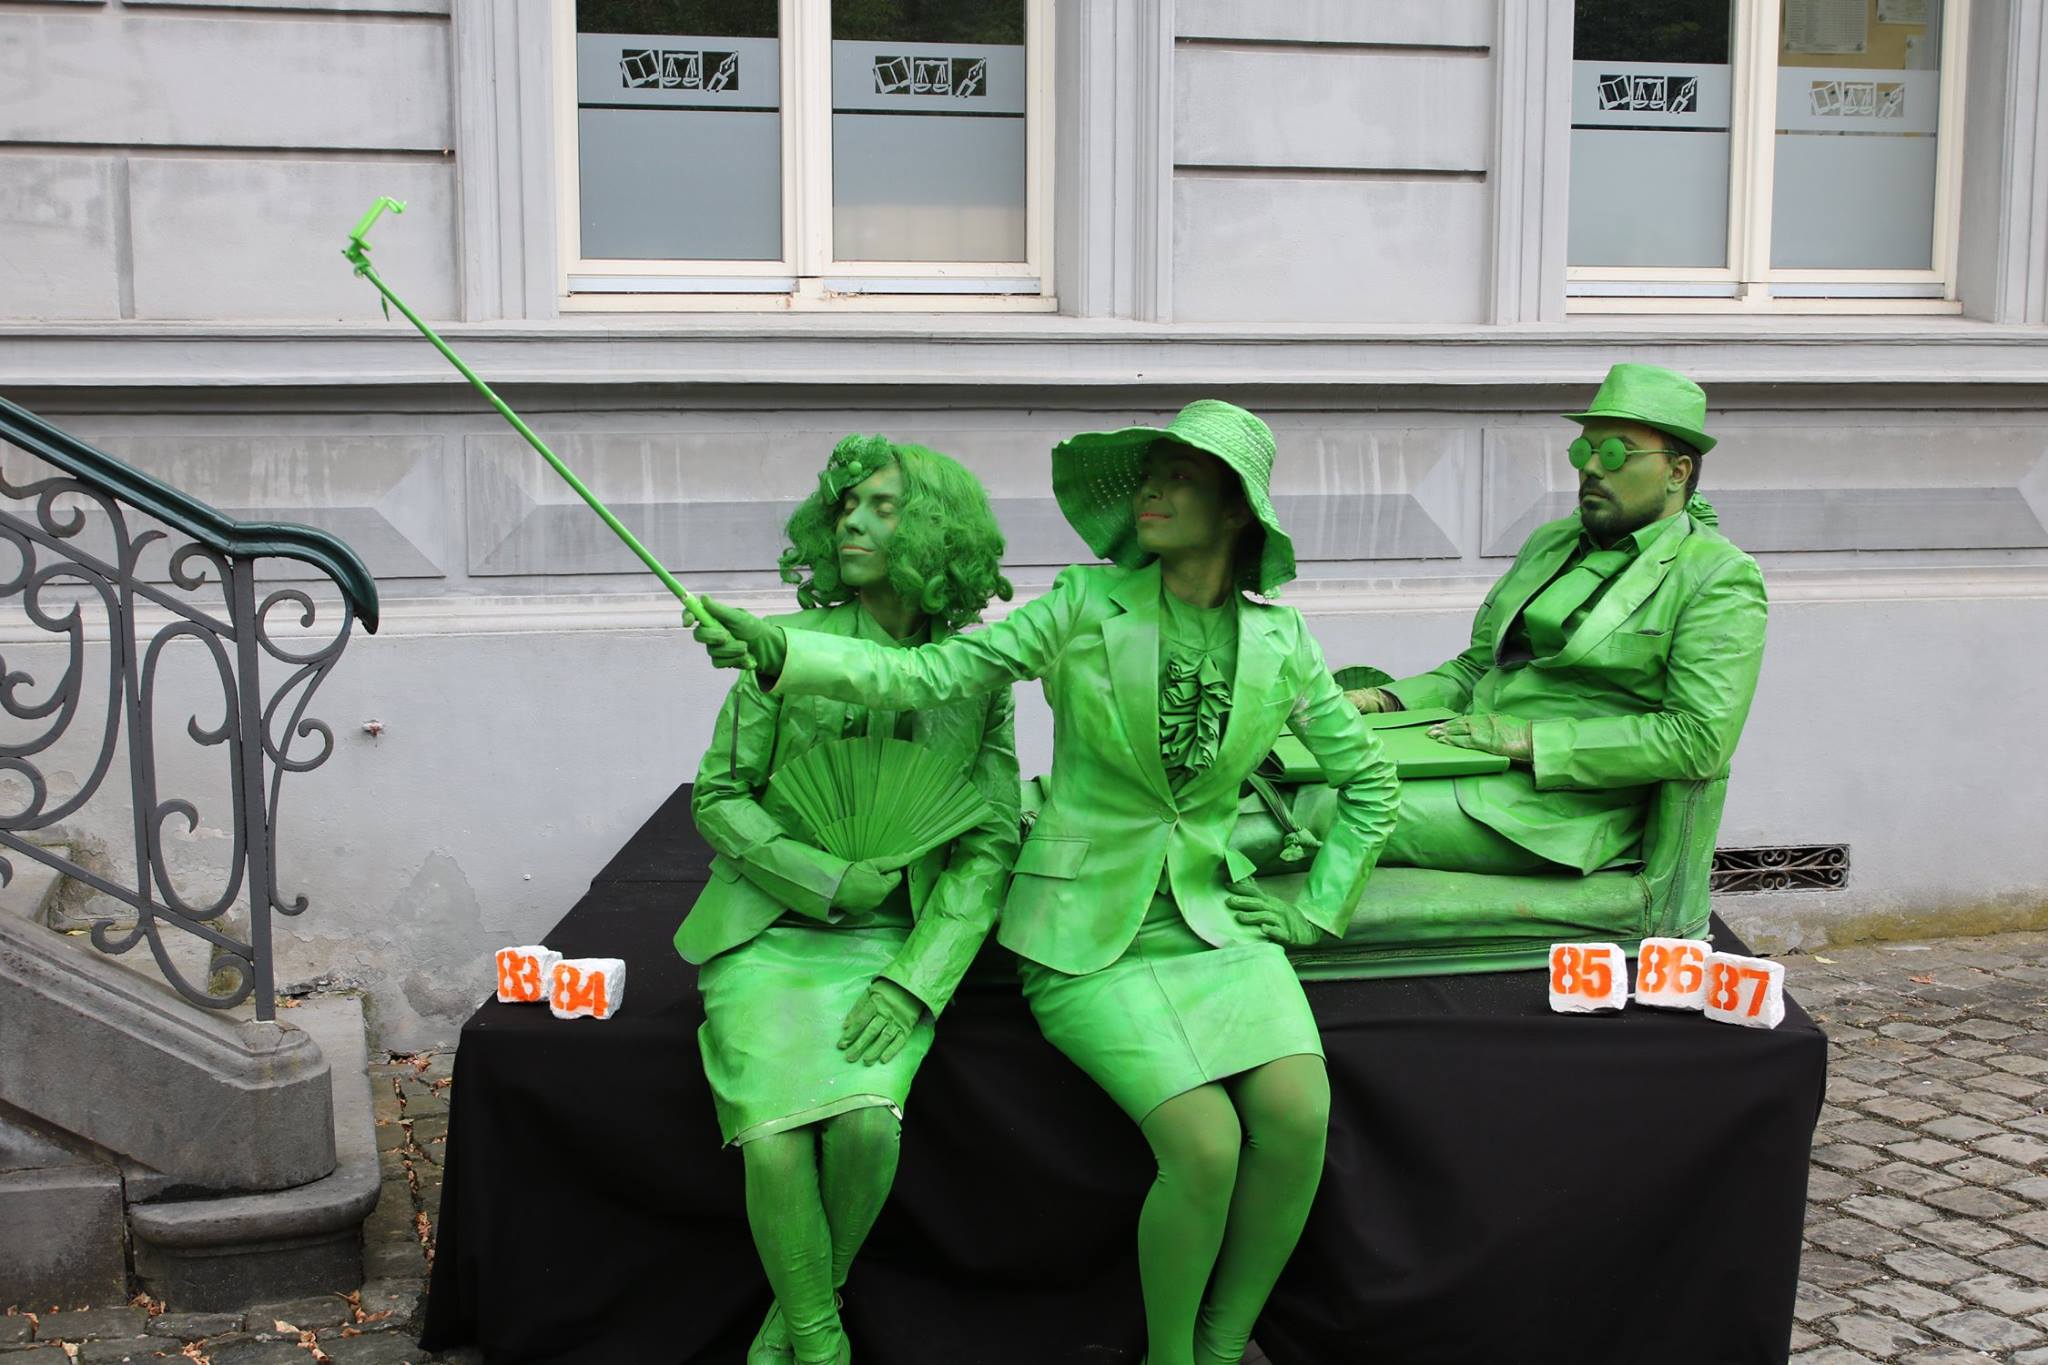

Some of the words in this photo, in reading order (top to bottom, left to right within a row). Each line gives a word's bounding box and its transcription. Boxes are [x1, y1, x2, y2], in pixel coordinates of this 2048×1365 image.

[496, 950, 540, 1002] 83
[552, 964, 608, 1017] 84
[1551, 946, 1611, 998] 85
[1638, 945, 1704, 994] 86
[1708, 962, 1770, 1017] 87
